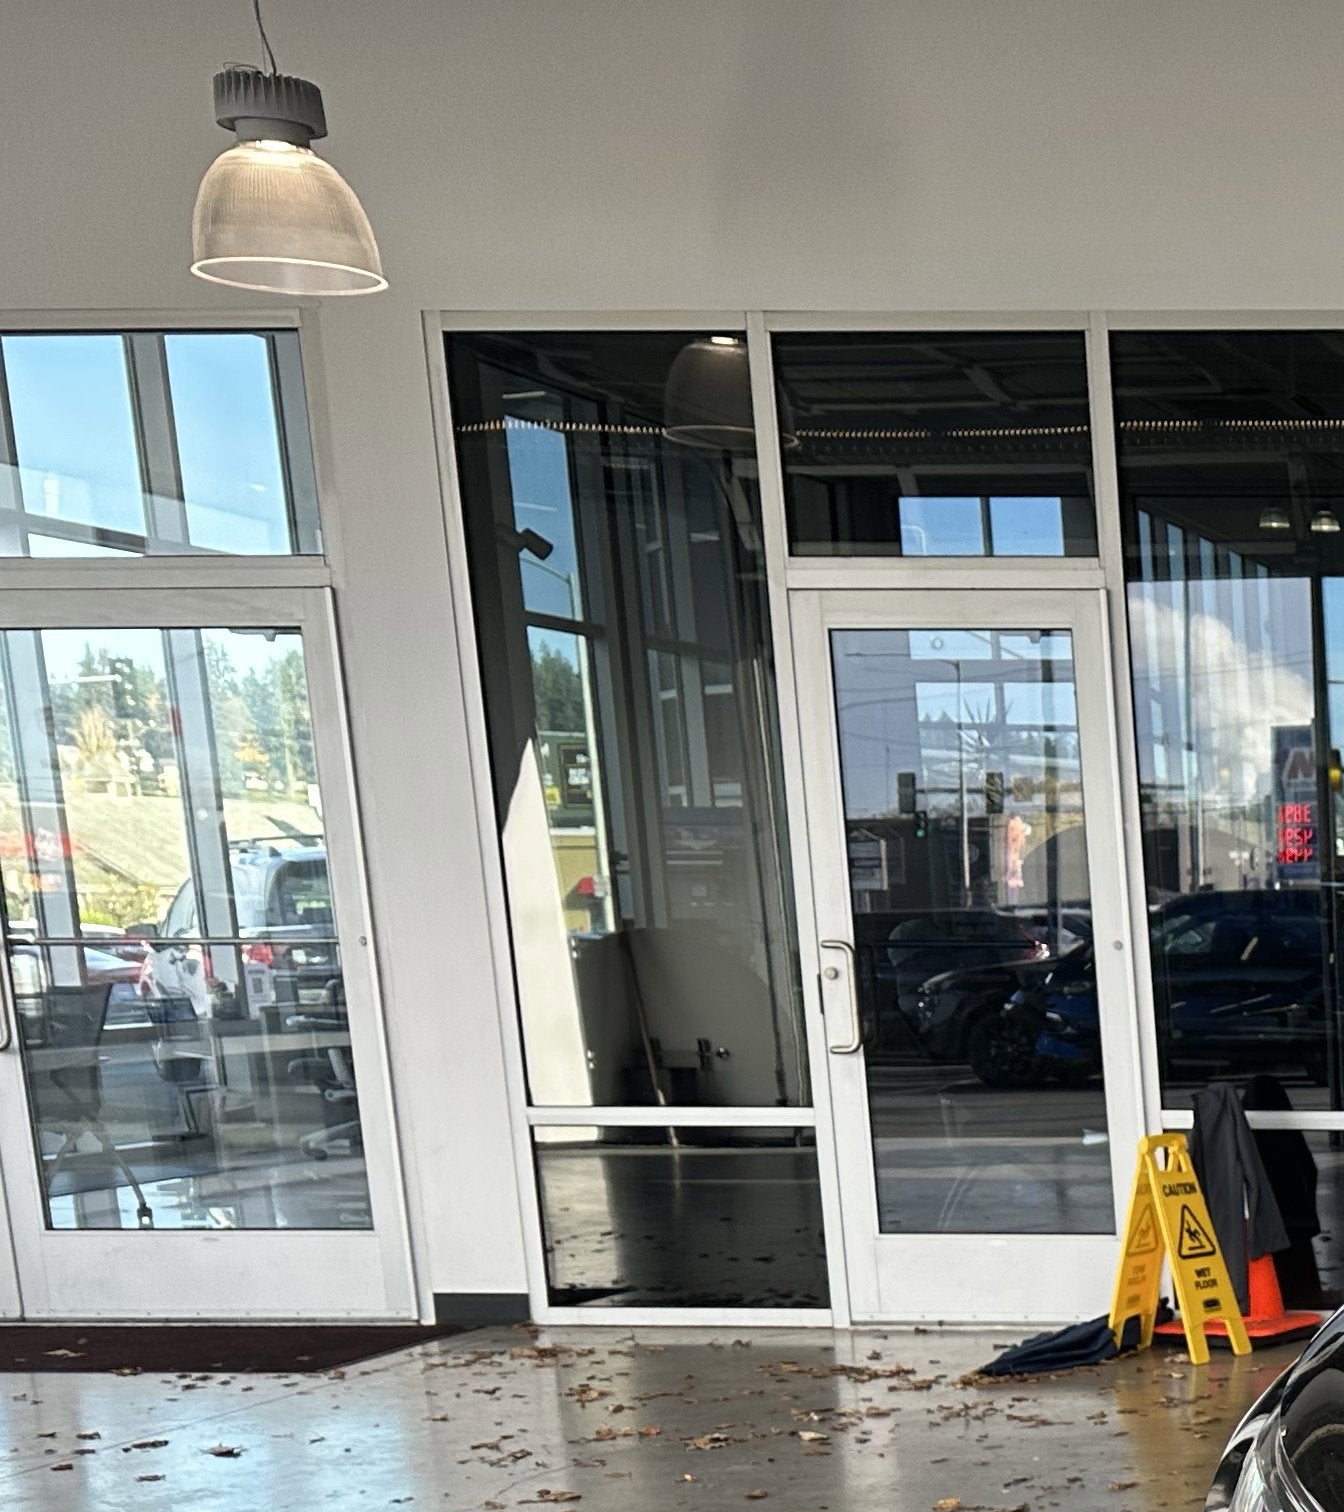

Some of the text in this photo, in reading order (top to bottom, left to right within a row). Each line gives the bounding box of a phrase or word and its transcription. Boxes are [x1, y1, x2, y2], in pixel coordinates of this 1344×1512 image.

[1162, 1182, 1197, 1197] CAUTION
[1194, 1267, 1211, 1278] WET
[1194, 1278, 1218, 1290] FLOOR
